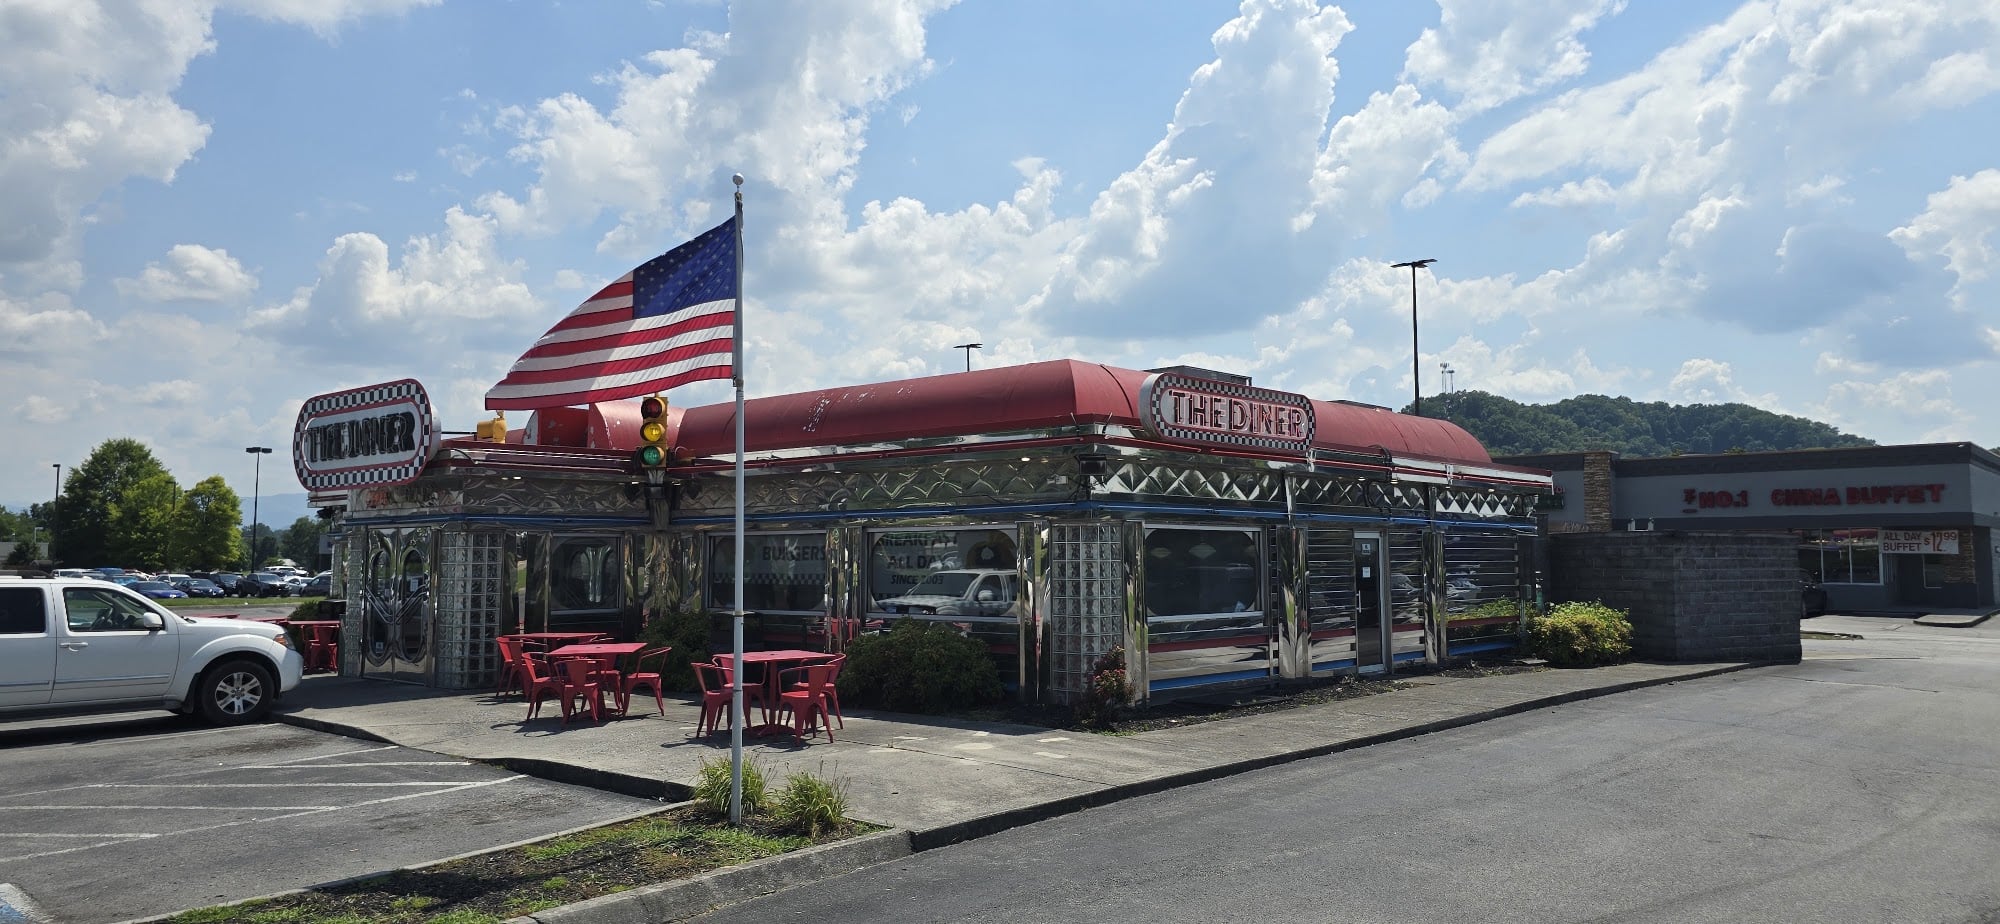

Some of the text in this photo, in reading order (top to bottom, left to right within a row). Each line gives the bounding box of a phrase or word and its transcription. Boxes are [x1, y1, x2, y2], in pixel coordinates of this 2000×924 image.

[1169, 388, 1307, 439] THE DINER
[305, 411, 415, 463] THE DINER
[1698, 489, 1748, 509] NO.1
[1771, 484, 1946, 506] CHINA BUFFET
[1883, 531, 1901, 541] ALL
[1903, 531, 1922, 541] DAY
[762, 545, 826, 561] BURGERS
[1883, 542, 1922, 552] BUFFET
[887, 555, 914, 569] ALL
[890, 574, 944, 585] SINCE 2003
